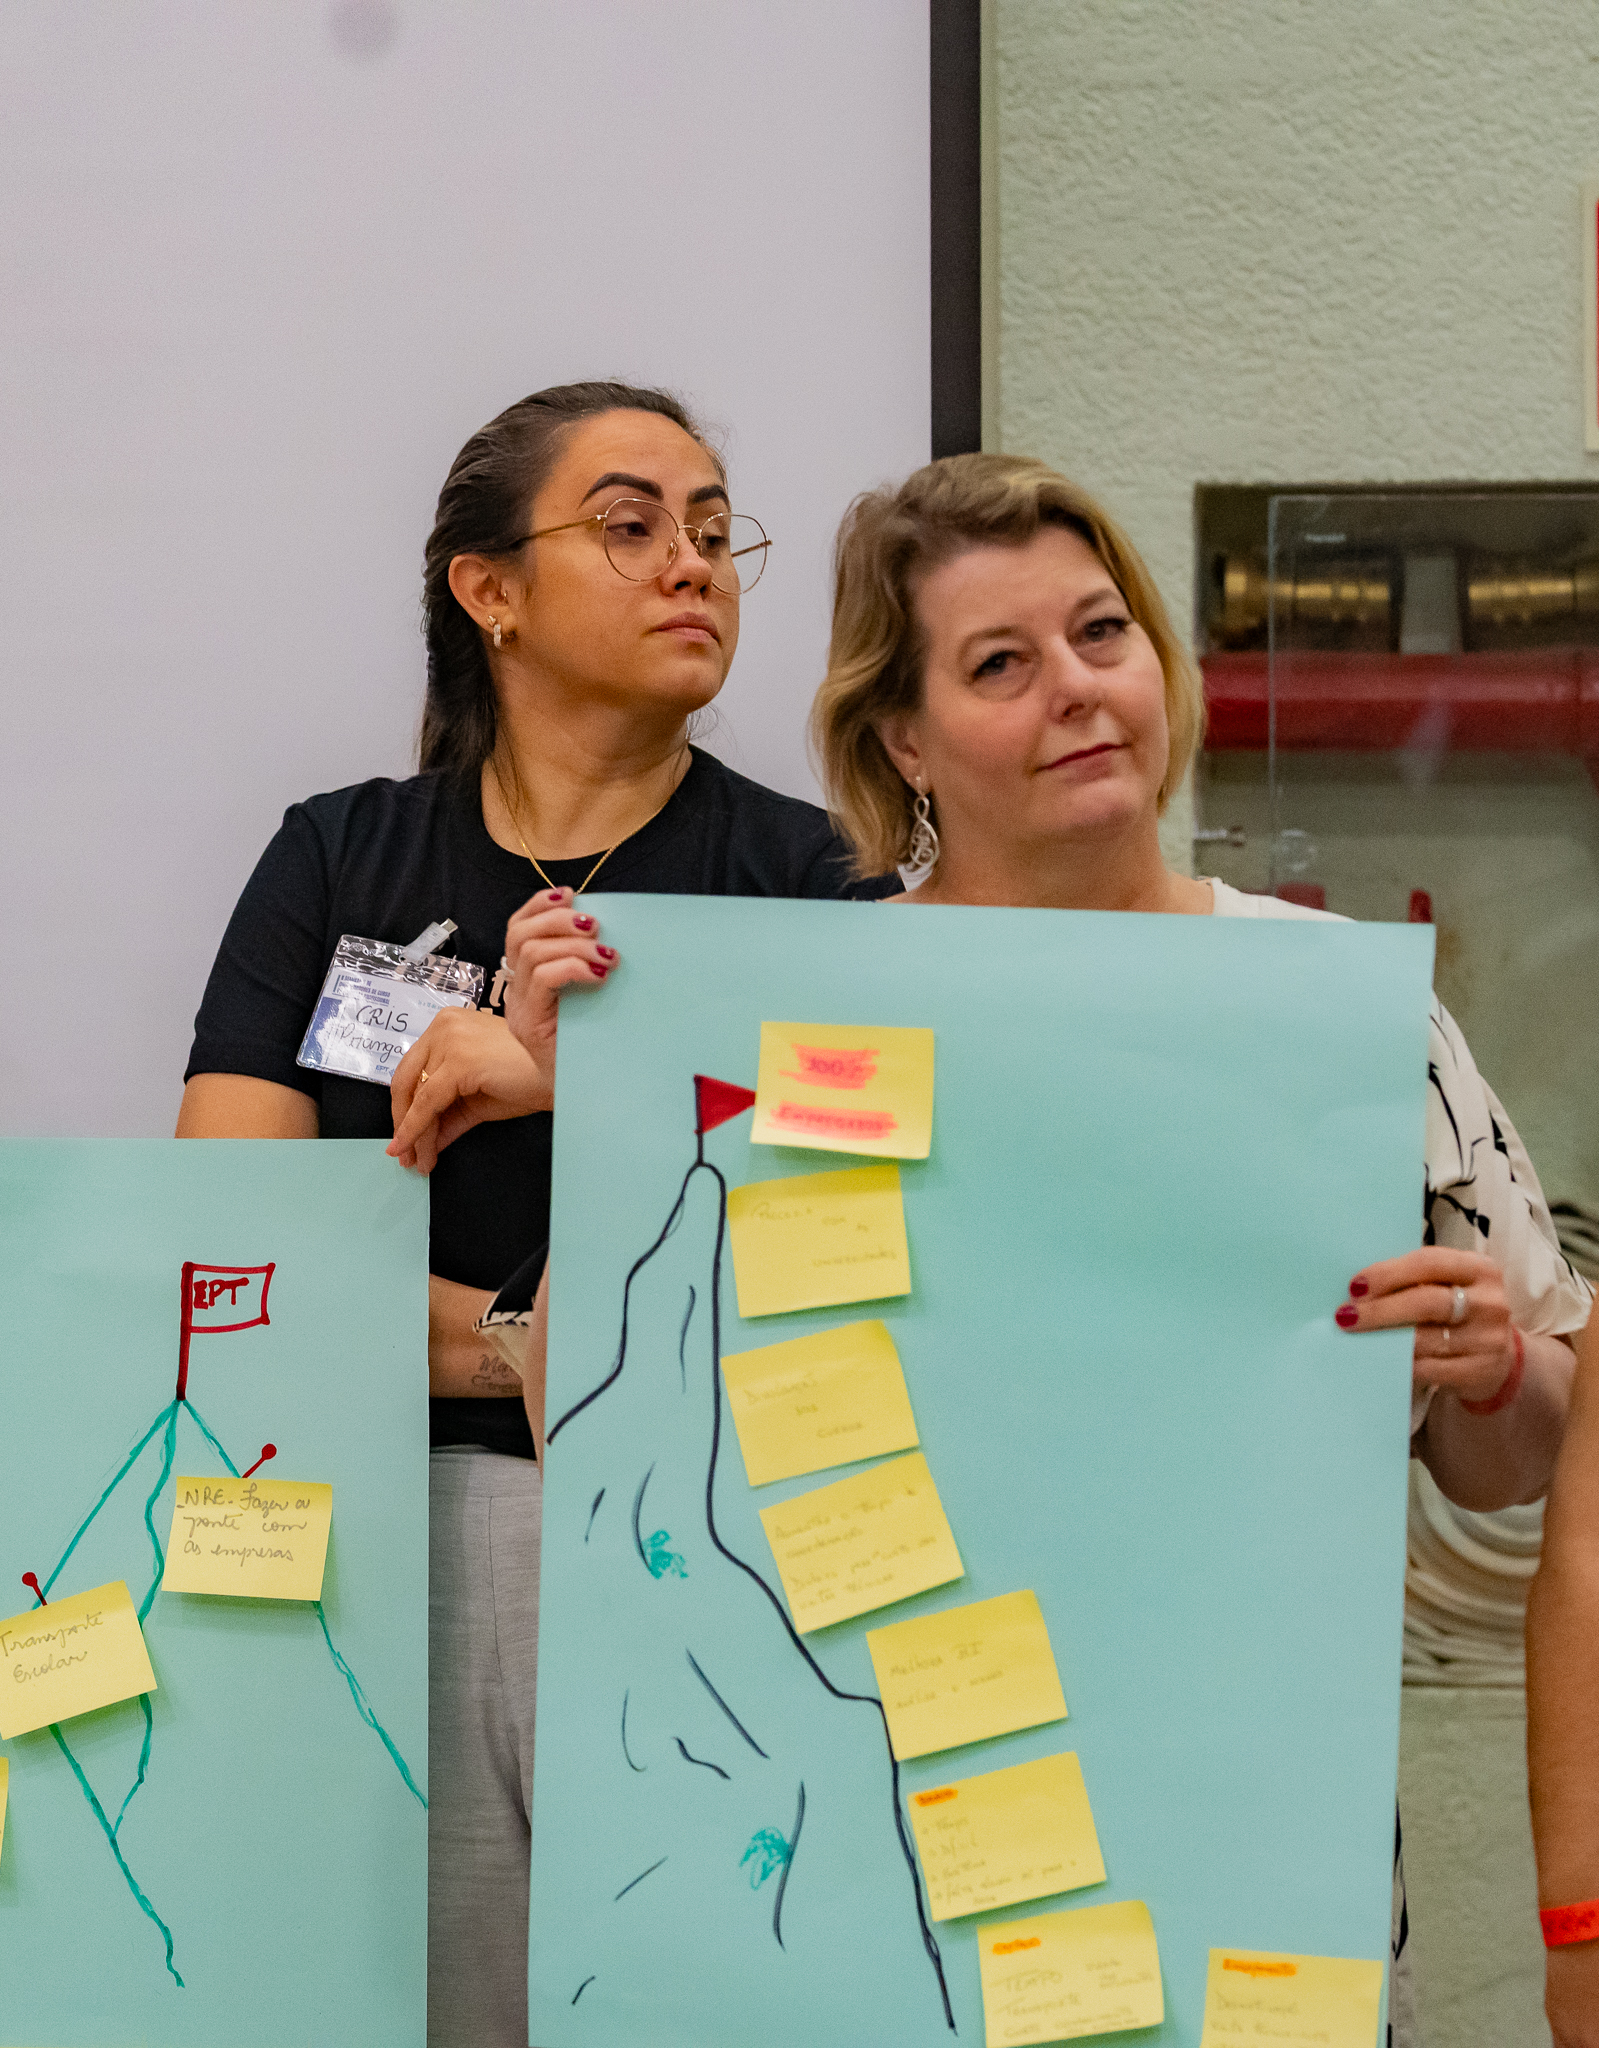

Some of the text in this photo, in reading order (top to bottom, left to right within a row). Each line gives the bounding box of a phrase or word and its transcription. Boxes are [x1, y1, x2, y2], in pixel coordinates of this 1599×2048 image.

[356, 1005, 410, 1034] CRIS
[193, 1277, 250, 1311] EPT
[262, 1521, 308, 1533] com
[211, 1544, 294, 1568] empresas
[0, 1611, 104, 1657] Transporte
